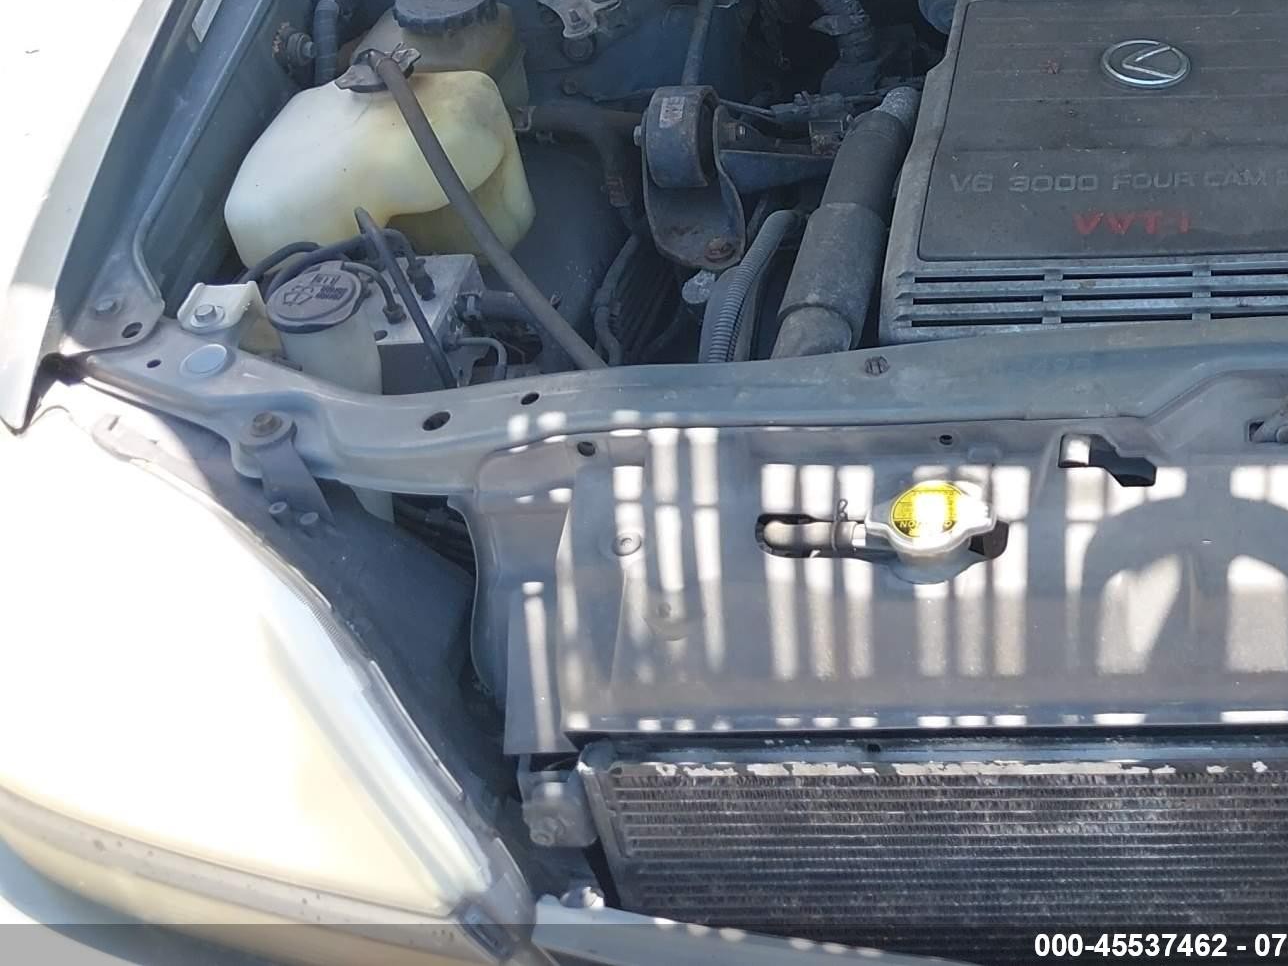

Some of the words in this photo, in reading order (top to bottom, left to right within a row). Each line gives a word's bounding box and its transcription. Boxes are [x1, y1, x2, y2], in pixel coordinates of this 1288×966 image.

[951, 174, 993, 193] V6
[1008, 174, 1098, 192] 3000
[1112, 171, 1196, 190] FOUR
[1205, 169, 1268, 187] CAM
